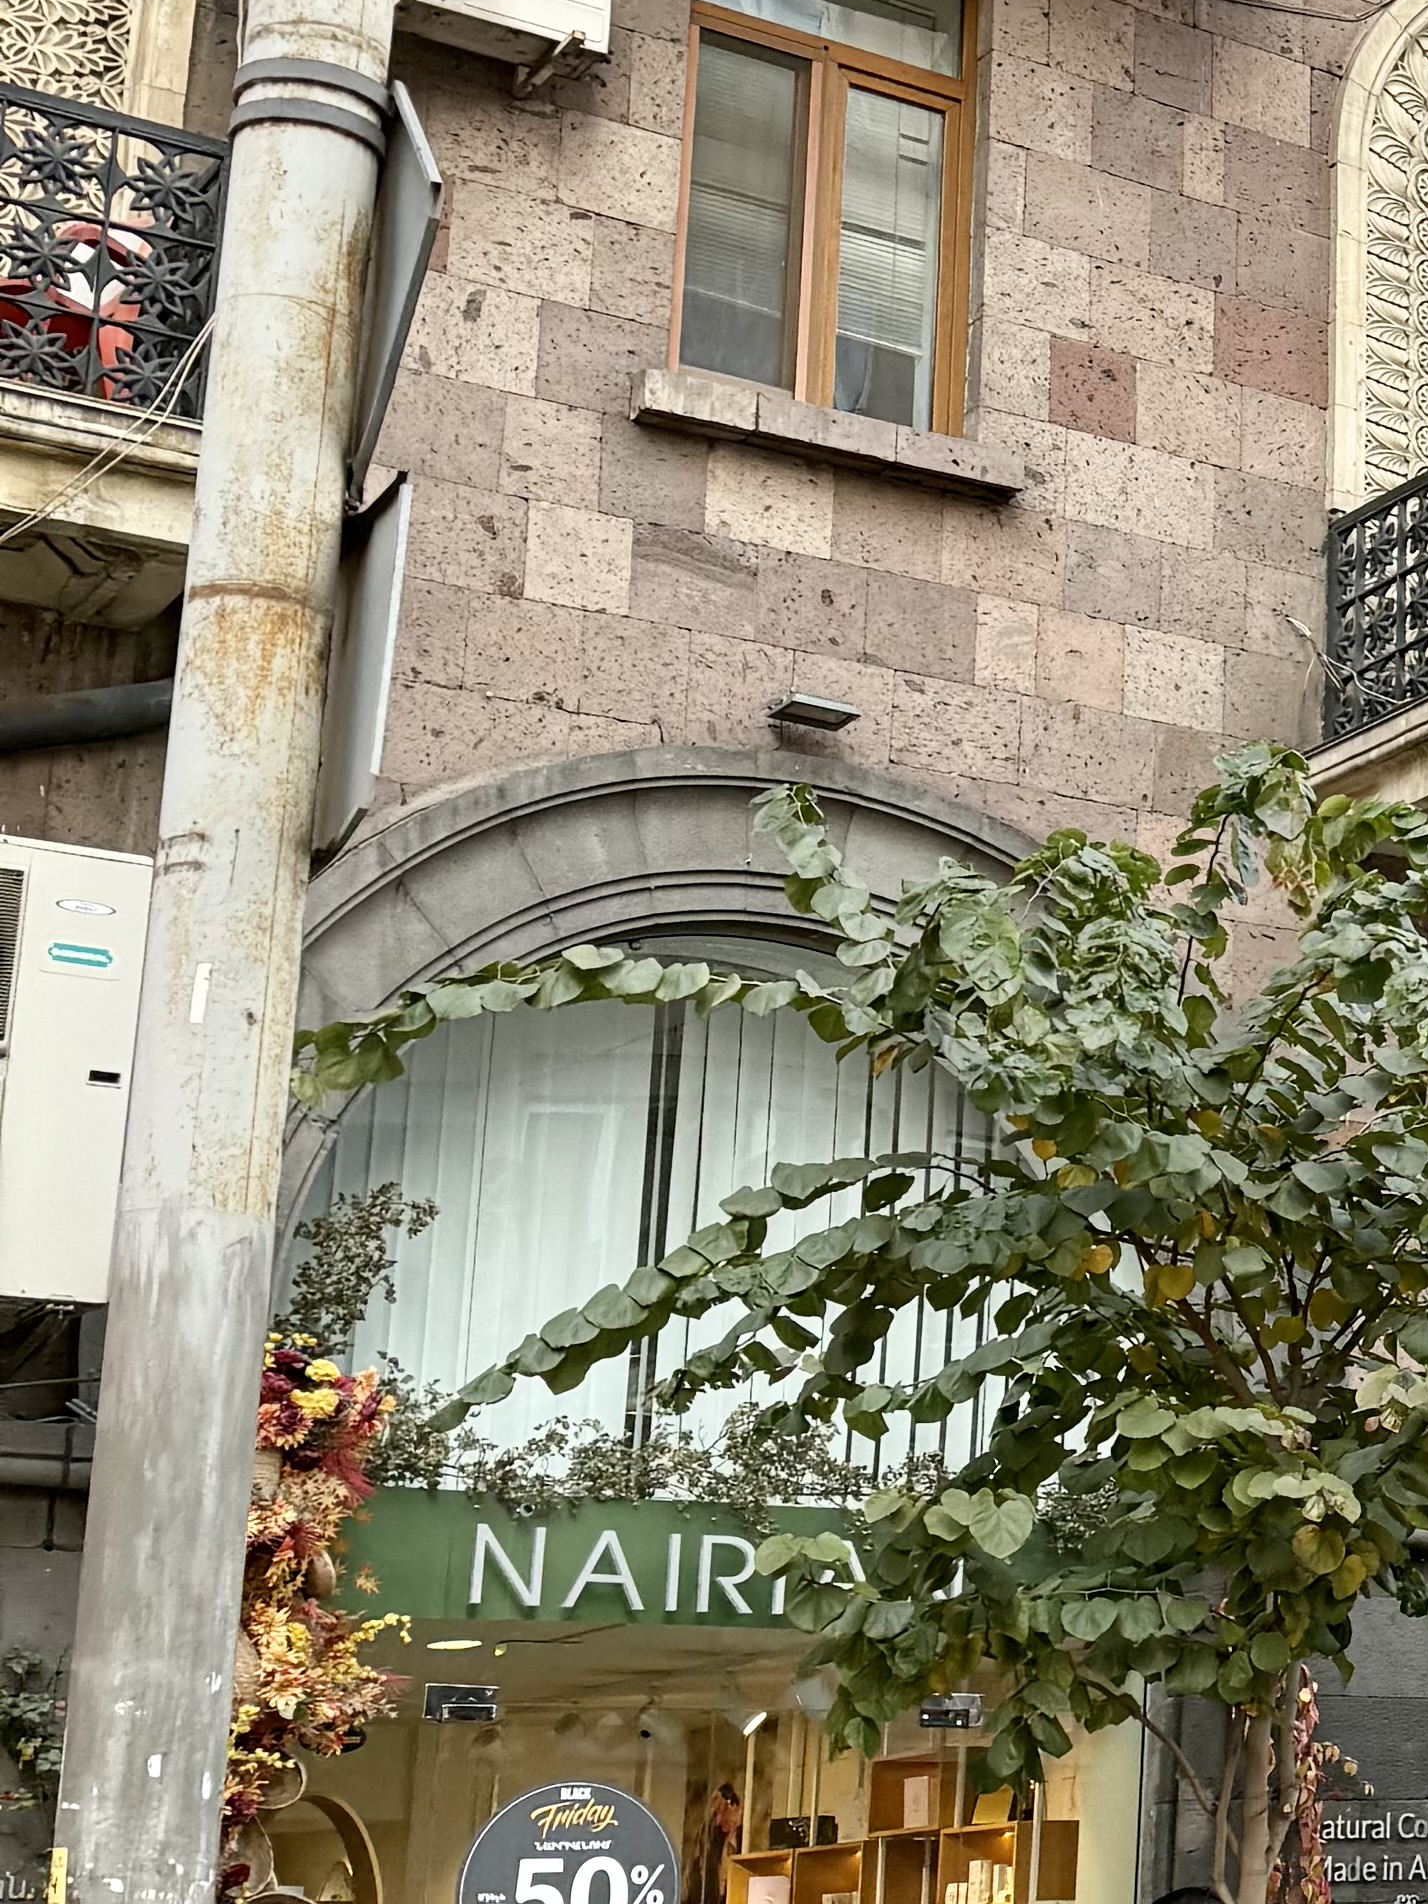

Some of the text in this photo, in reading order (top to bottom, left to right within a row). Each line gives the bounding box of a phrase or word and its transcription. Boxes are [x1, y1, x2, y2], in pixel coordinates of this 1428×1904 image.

[530, 1798, 618, 1839] Friday
[1316, 1811, 1391, 1841] atural
[1382, 1854, 1403, 1881] in
